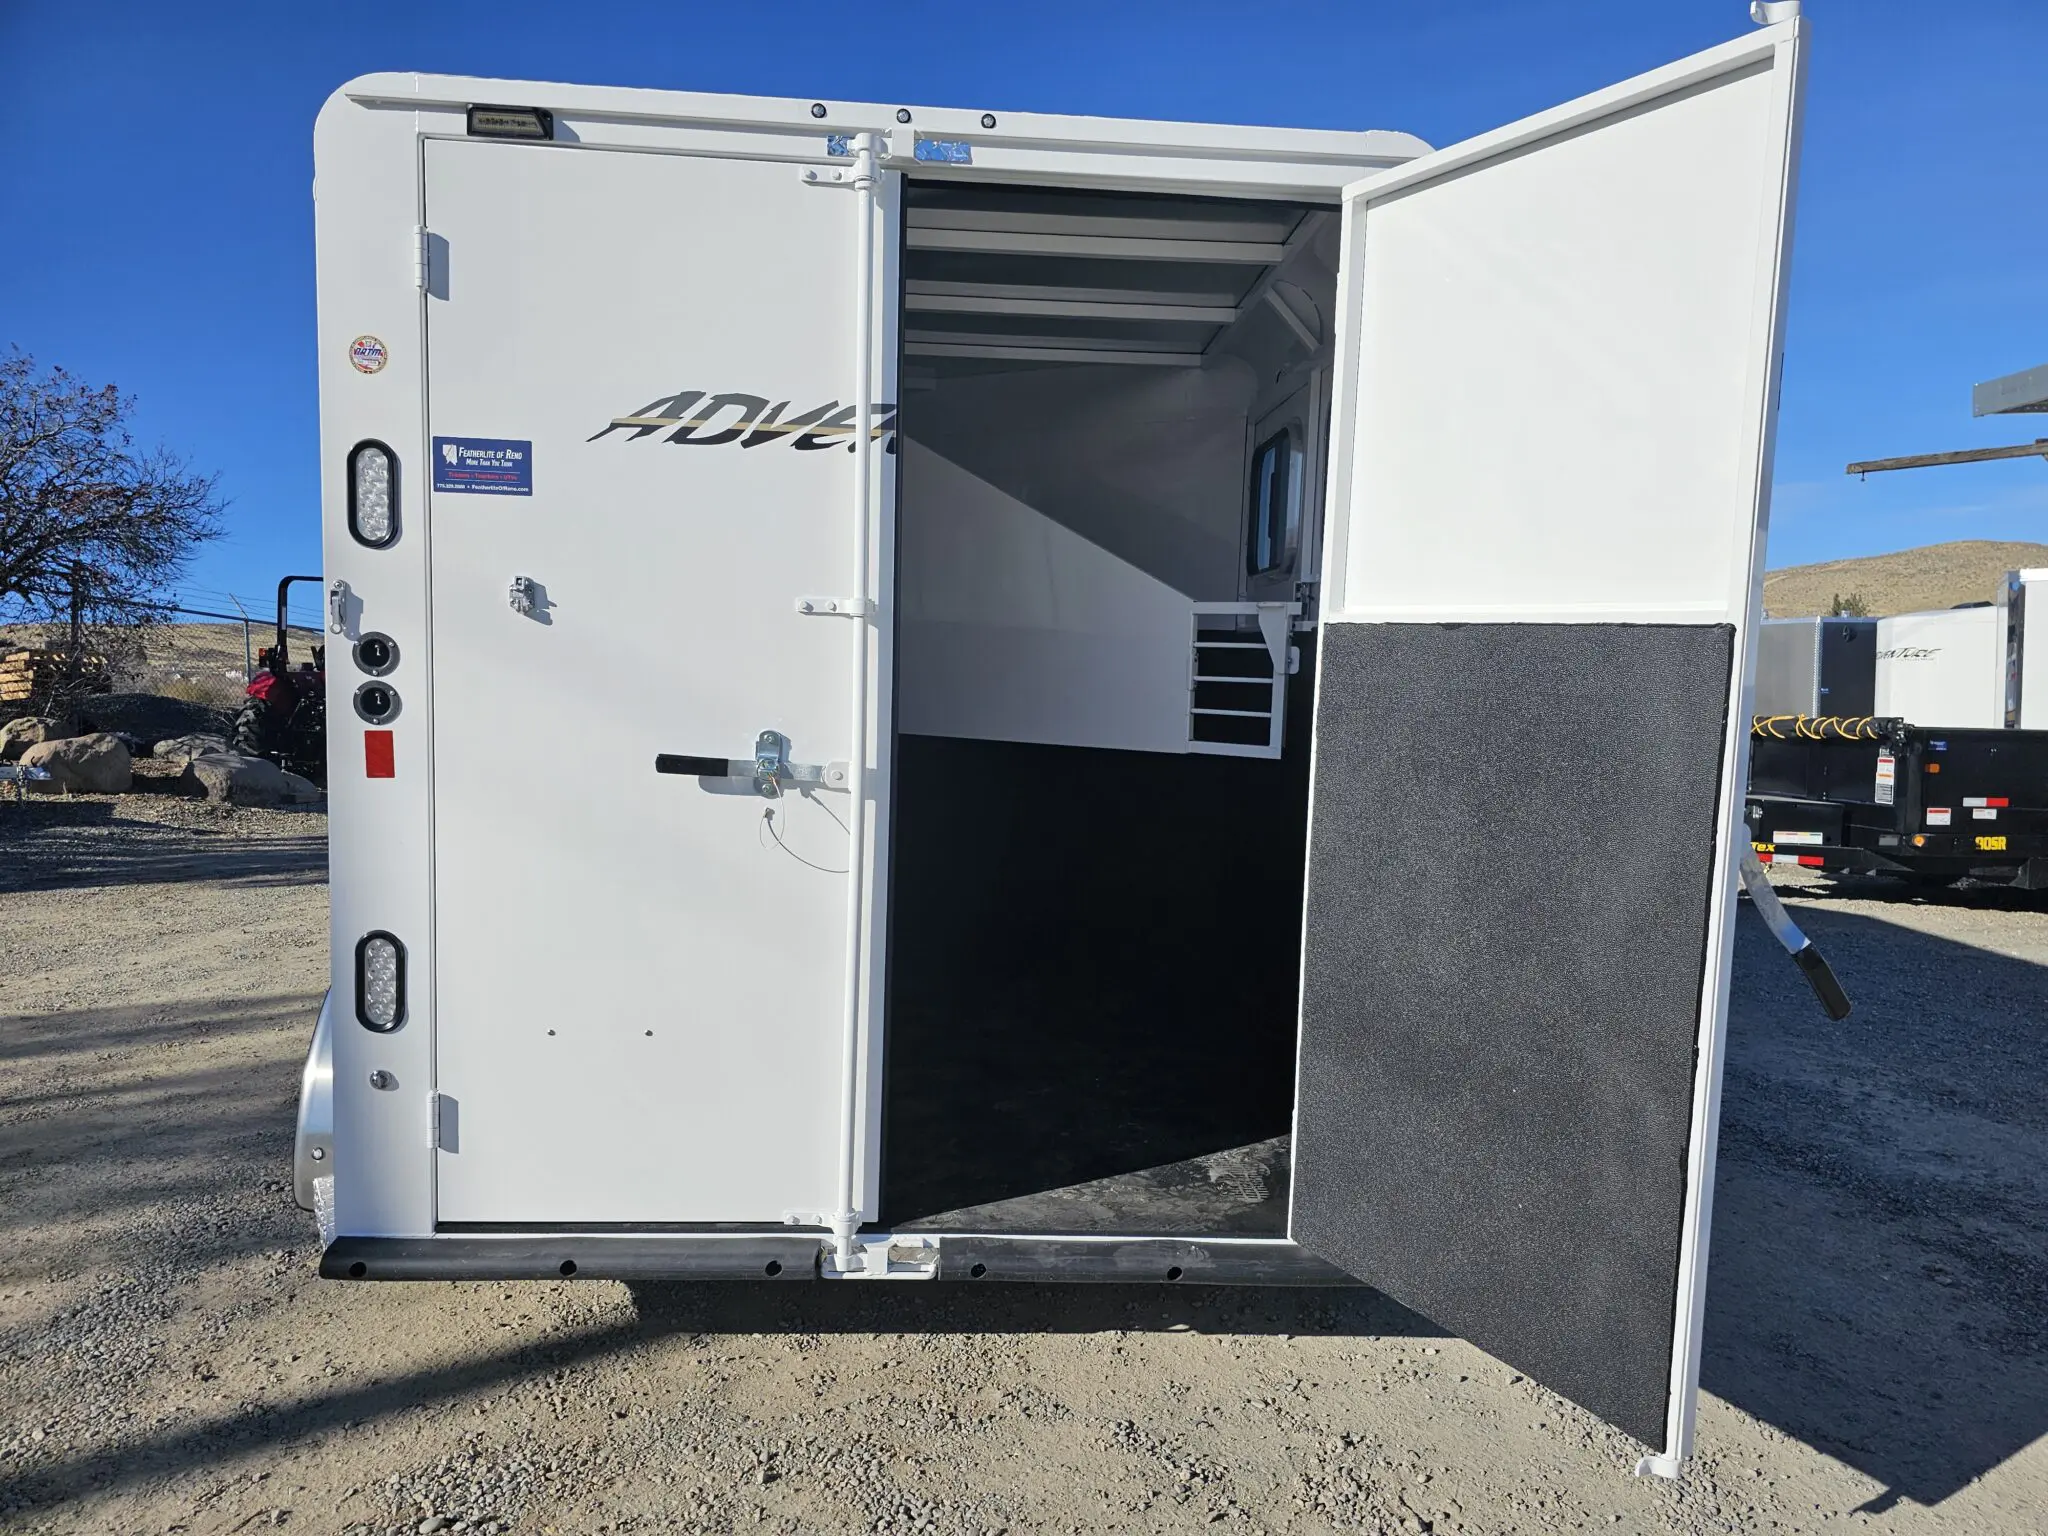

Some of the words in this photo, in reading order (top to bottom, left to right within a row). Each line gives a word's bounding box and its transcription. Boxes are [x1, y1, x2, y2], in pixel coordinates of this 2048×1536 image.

[458, 447, 496, 459] FEATHERLITE
[496, 451, 504, 459] OF
[505, 448, 523, 460] RENO
